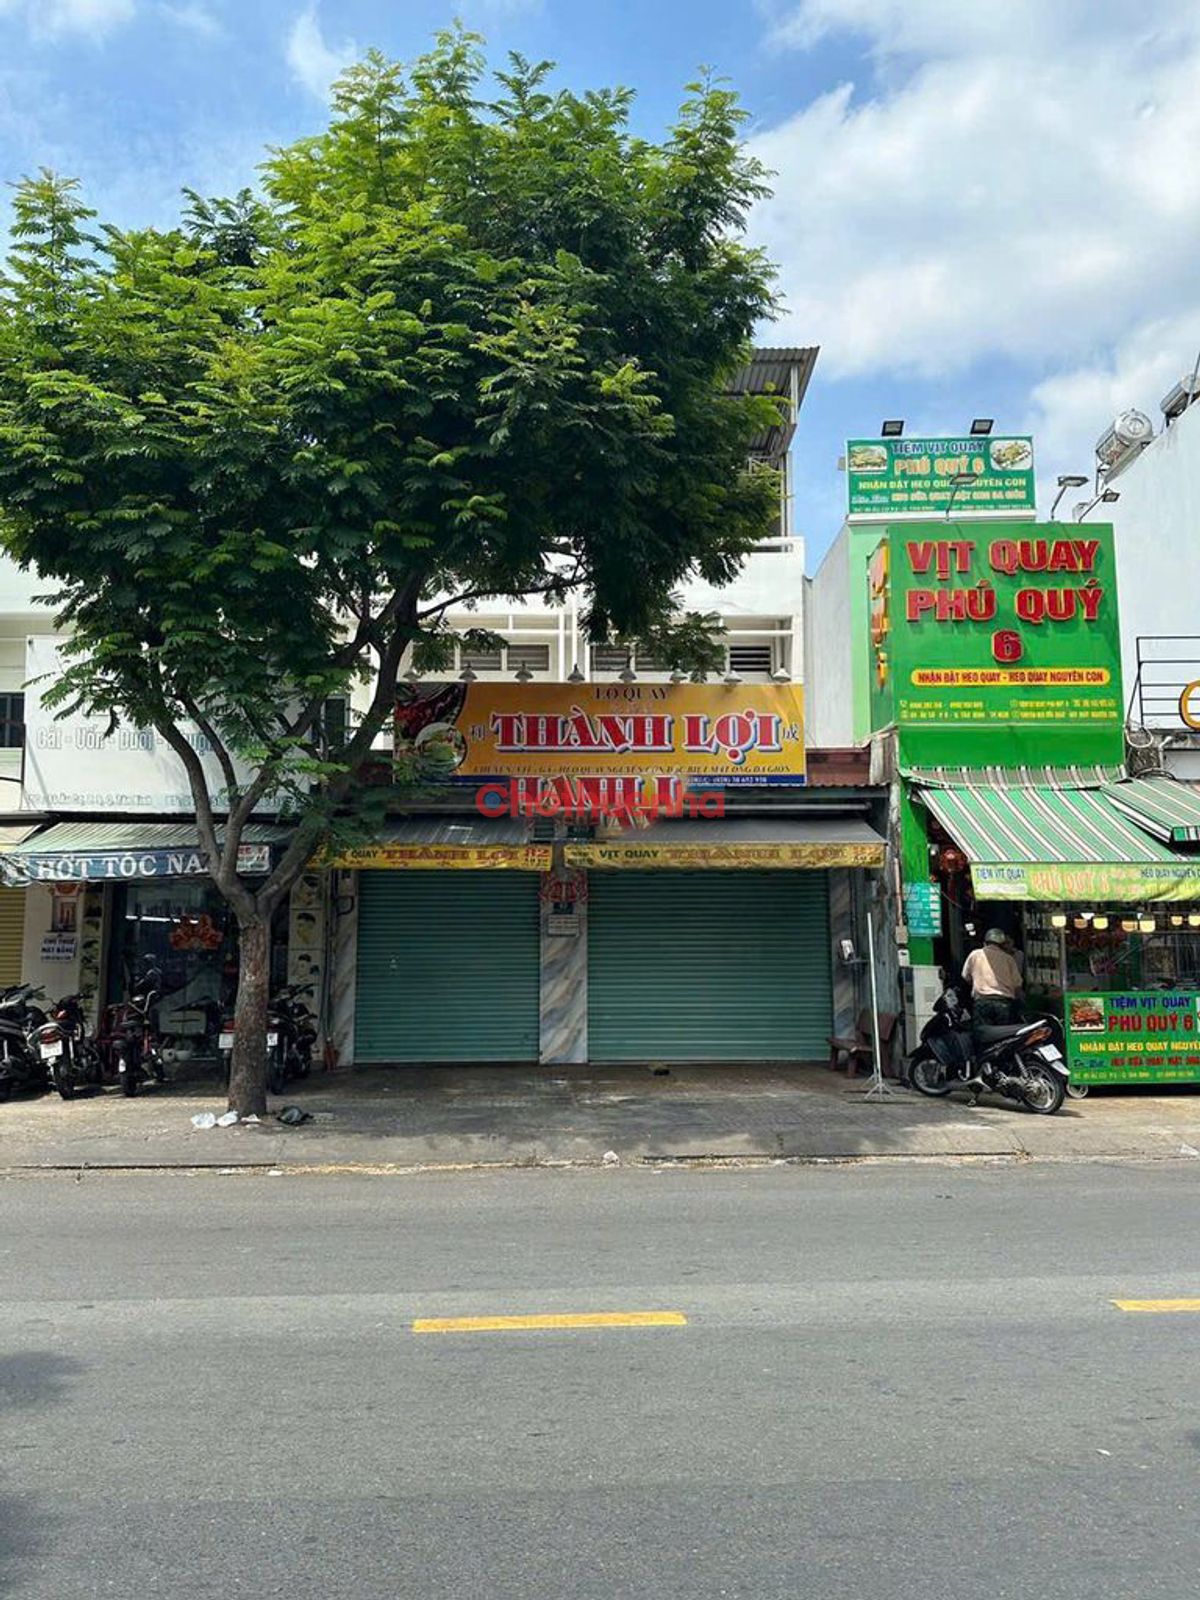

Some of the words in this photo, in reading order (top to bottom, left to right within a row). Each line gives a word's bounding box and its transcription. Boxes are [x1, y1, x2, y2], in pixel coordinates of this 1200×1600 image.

[927, 441, 947, 455] VỊT
[950, 440, 987, 453] QUAY
[1005, 477, 1026, 487] CON
[906, 541, 975, 580] VỊT
[989, 540, 1099, 576] QUAY
[906, 580, 997, 621] PHÚ
[1015, 578, 1103, 625] QUÝ
[992, 629, 1023, 663] 6
[918, 671, 942, 684] NHẬN
[962, 672, 978, 683] HEO
[980, 672, 1000, 683] QUAY
[1009, 671, 1025, 683] HEO
[1027, 671, 1047, 683] QUAY
[1050, 670, 1083, 682] NGUYÊN
[1086, 671, 1104, 682] CON
[490, 706, 675, 753] THÀNH
[682, 708, 783, 765] LỢI
[599, 850, 620, 859] VỊT
[624, 850, 660, 858] QUAY
[102, 853, 157, 877] TÓC
[1141, 997, 1156, 1009] VỊT
[1162, 996, 1190, 1008] QUAY
[1146, 1041, 1168, 1051] QUAY
